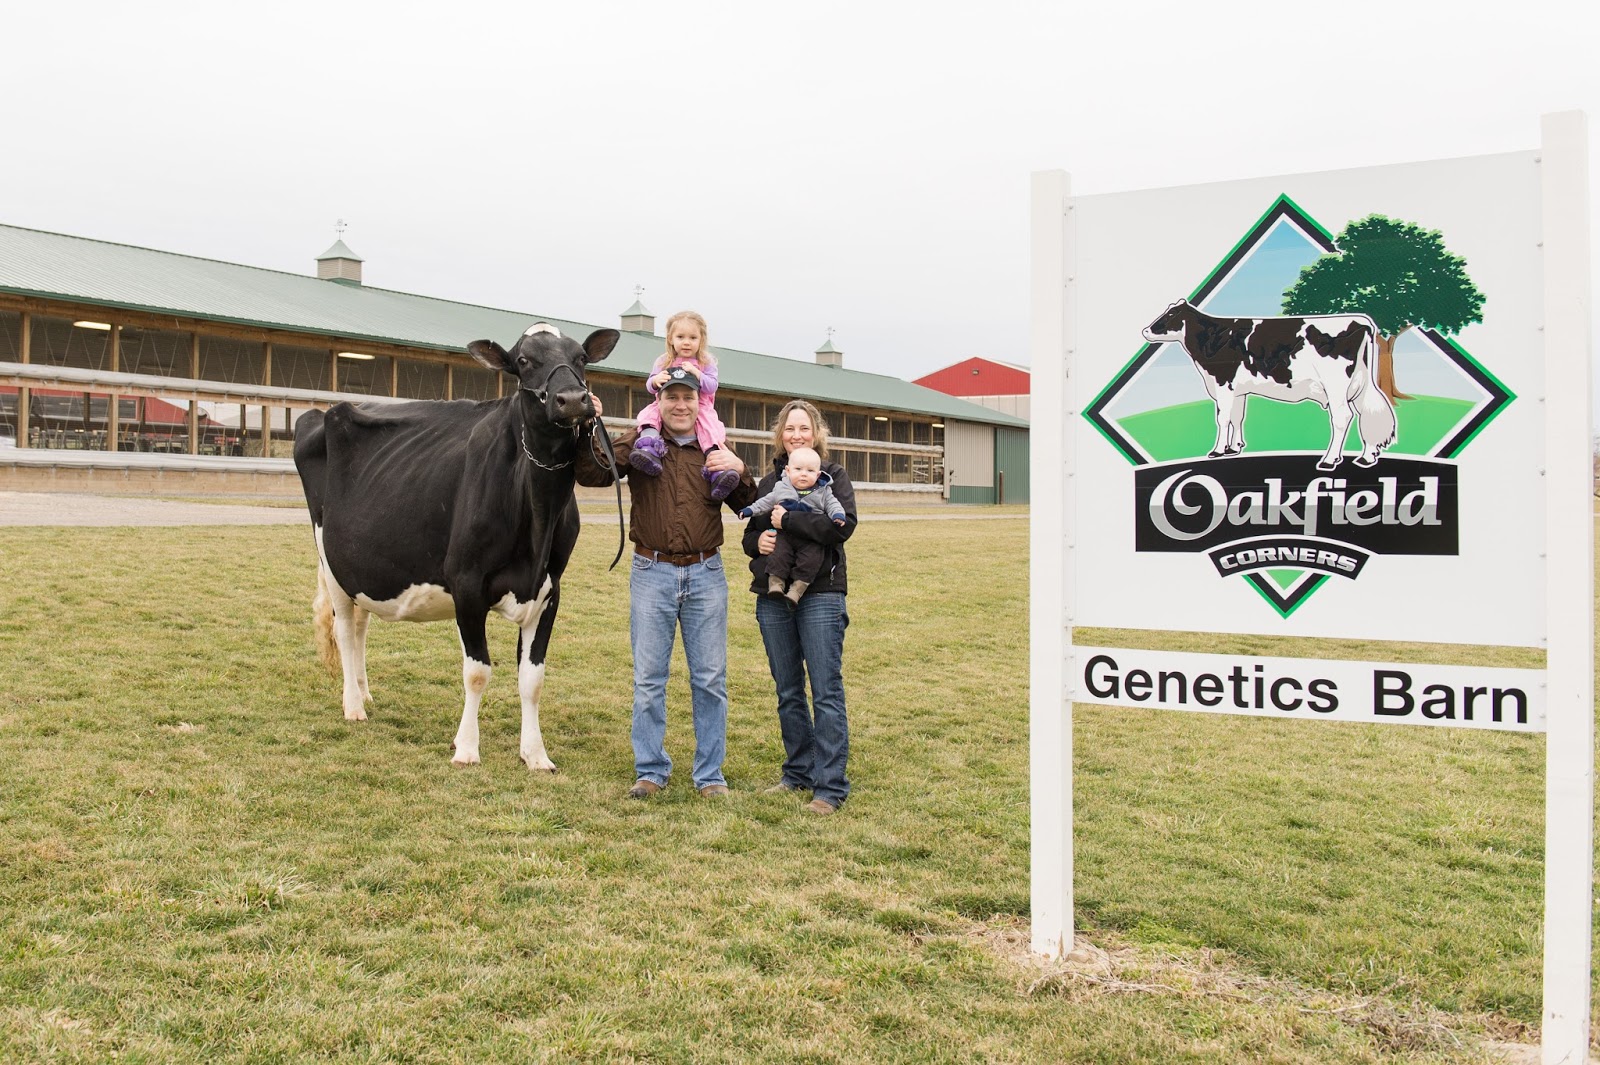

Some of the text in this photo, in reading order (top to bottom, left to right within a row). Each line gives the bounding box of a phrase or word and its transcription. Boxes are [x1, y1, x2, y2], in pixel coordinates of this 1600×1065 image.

[1148, 469, 1442, 541] Oakfield
[1219, 546, 1358, 572] CORNERS
[1084, 654, 1527, 724] Genetics Barn
